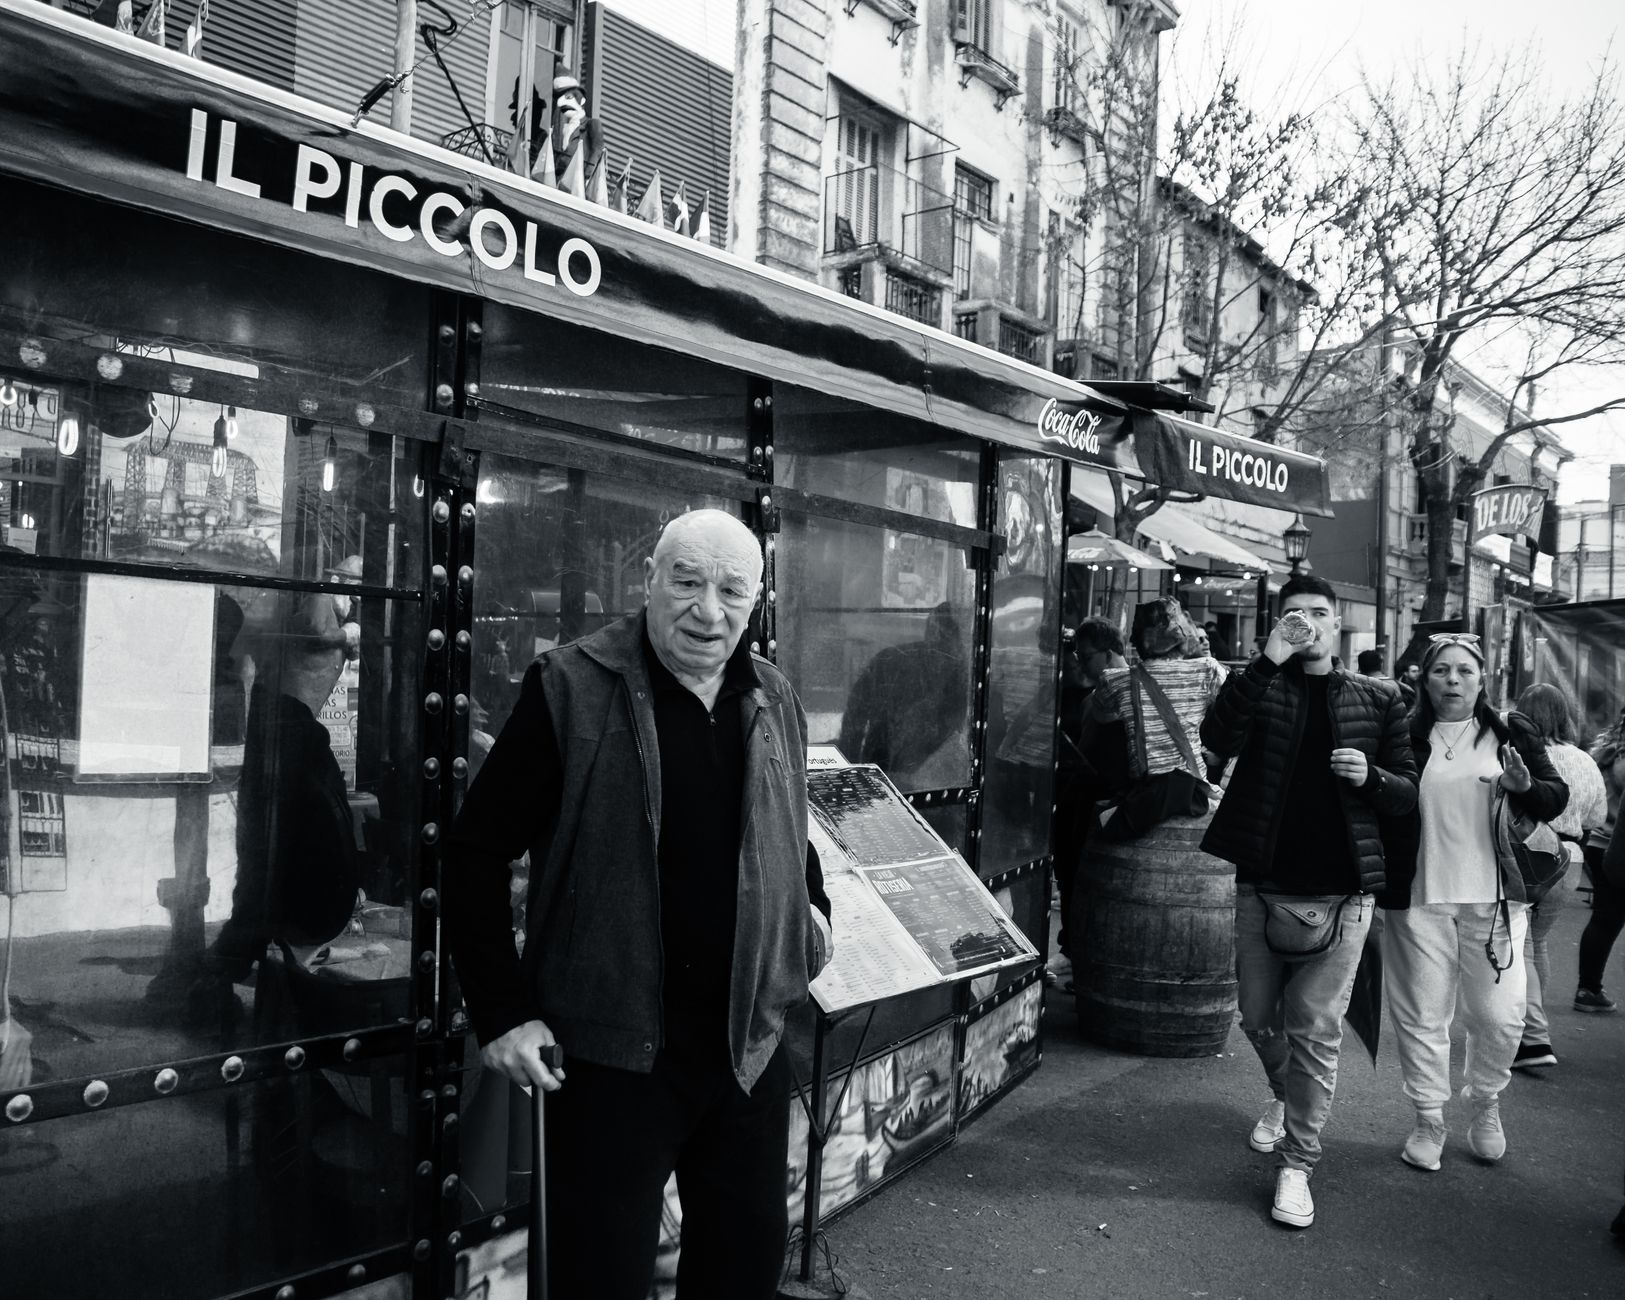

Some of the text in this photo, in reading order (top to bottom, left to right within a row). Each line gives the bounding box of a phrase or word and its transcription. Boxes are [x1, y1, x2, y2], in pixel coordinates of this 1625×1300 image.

[187, 108, 601, 297] IL PICCOLO
[1038, 398, 1102, 455] Coca-Cola
[1189, 439, 1289, 493] IL PICCOLO
[1475, 494, 1500, 532] DE
[1500, 490, 1533, 529] LOS
[331, 687, 346, 695] AS
